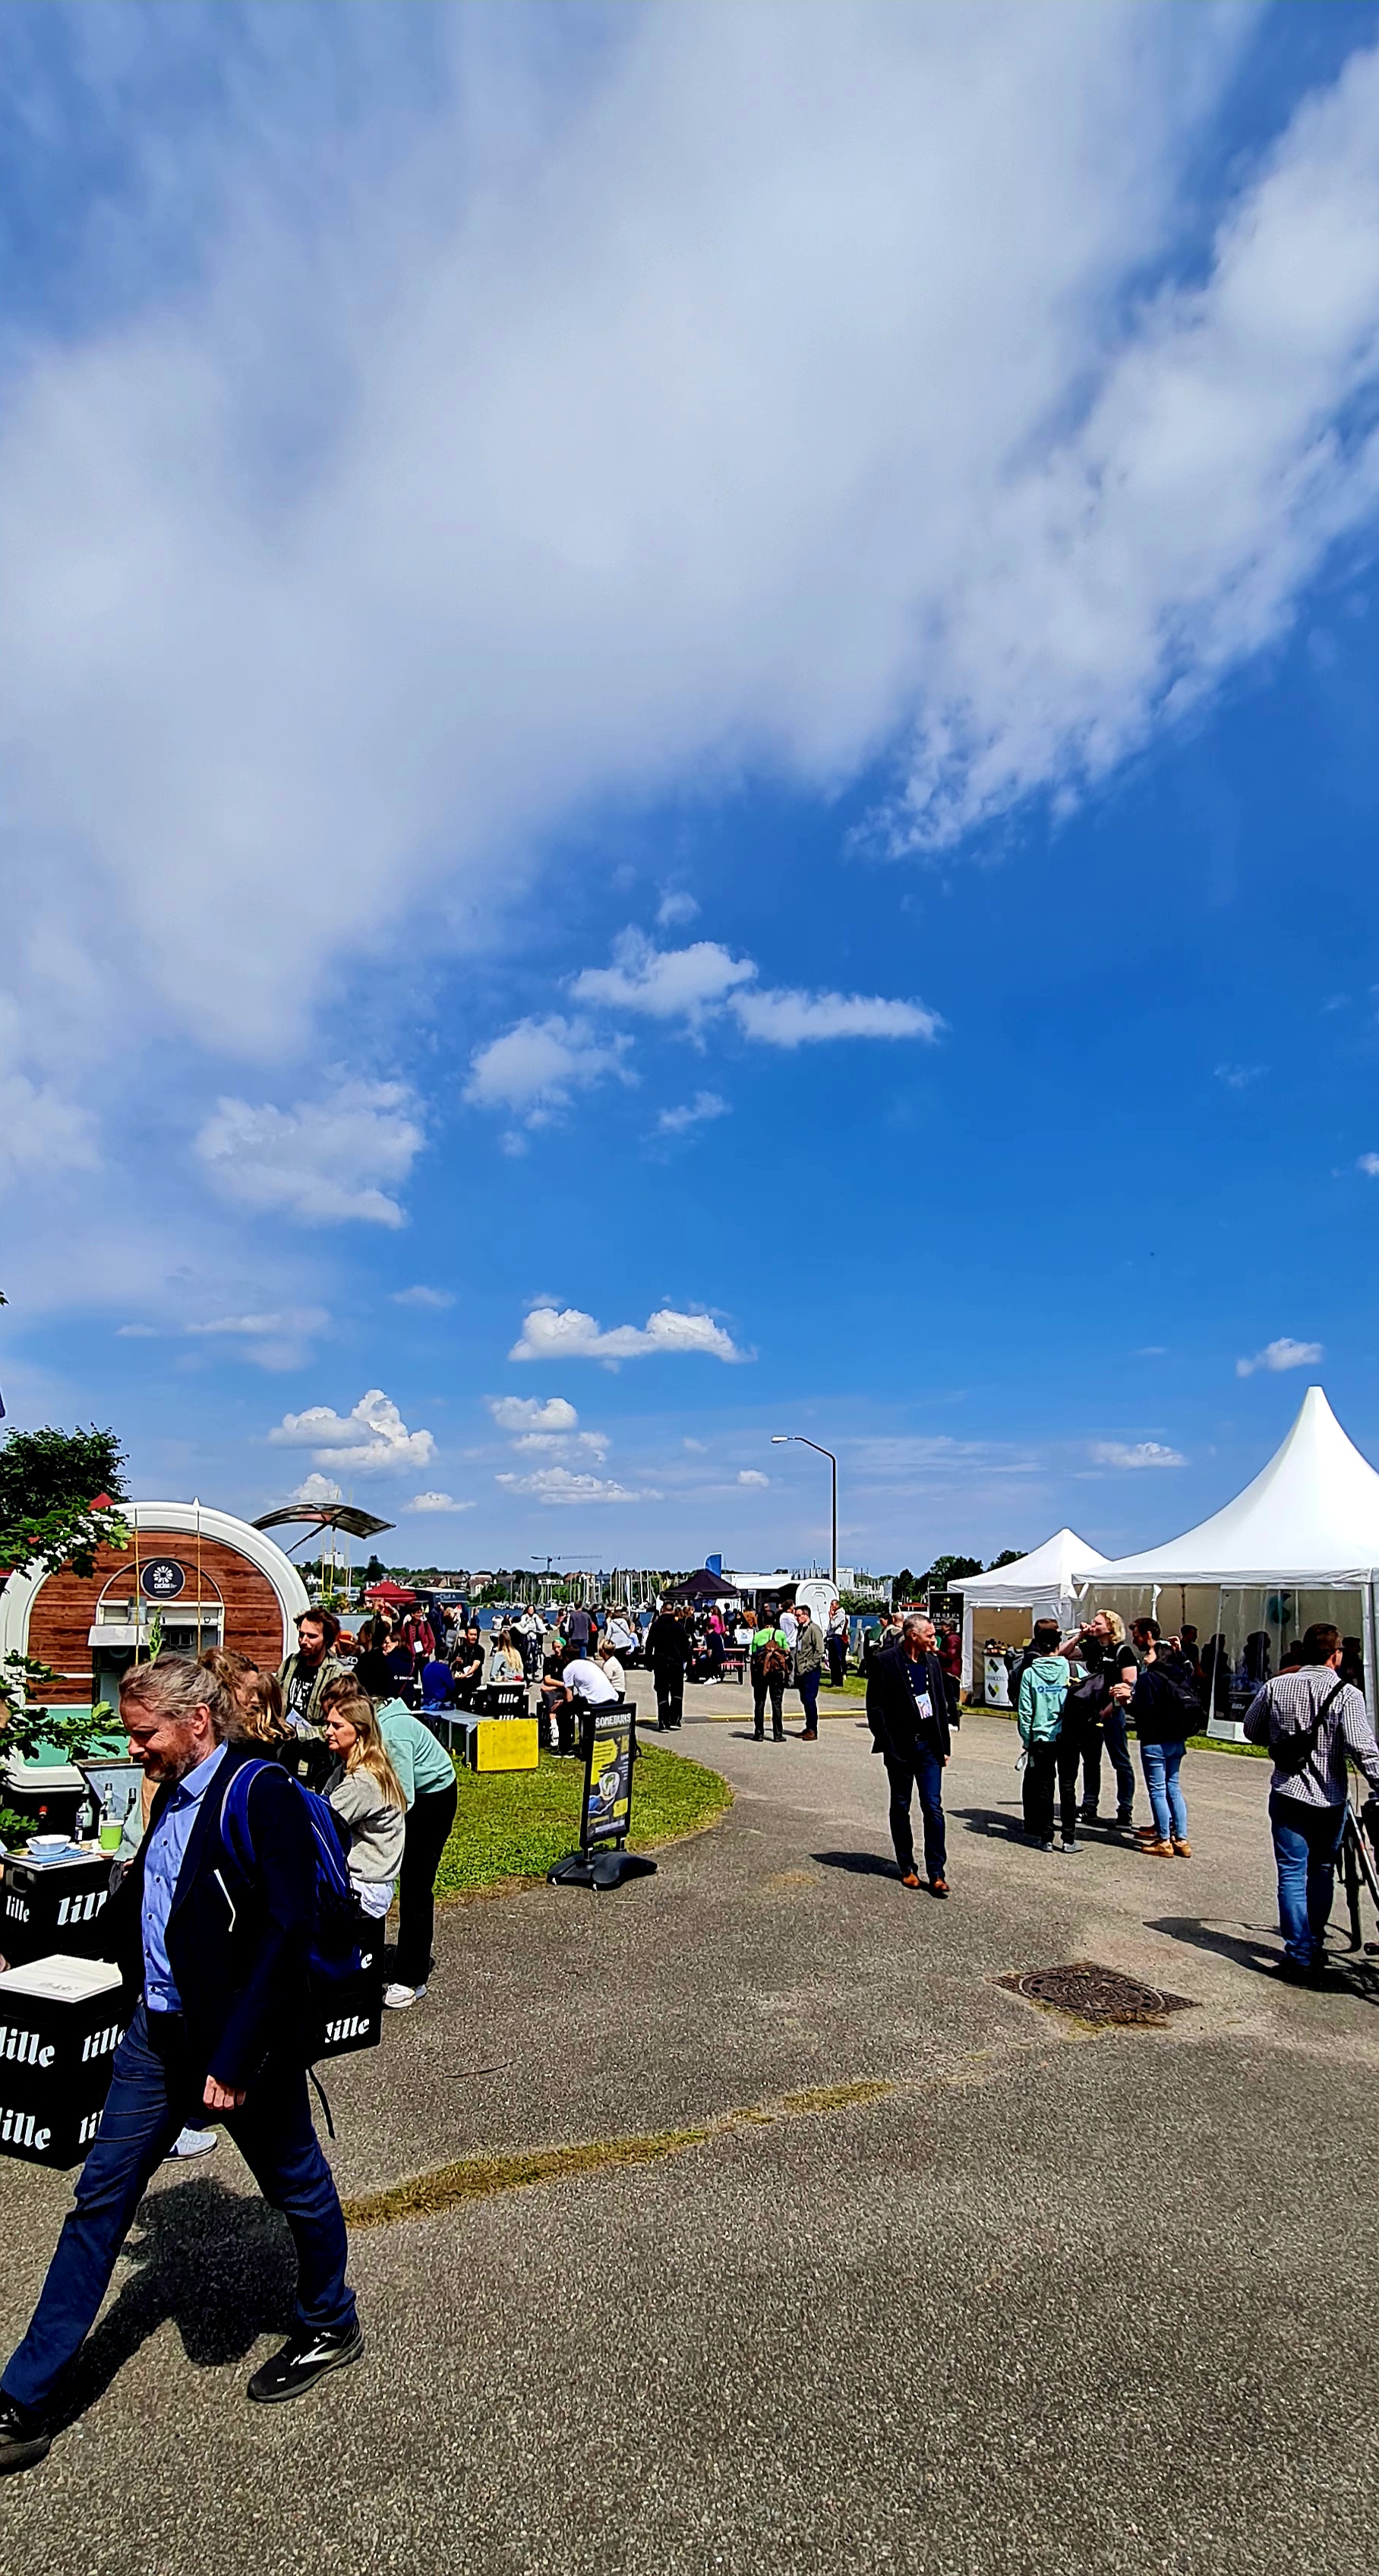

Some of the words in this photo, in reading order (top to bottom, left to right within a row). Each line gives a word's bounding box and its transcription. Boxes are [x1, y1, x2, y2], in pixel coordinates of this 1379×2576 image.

[498, 1694, 519, 1703] lille
[595, 1713, 631, 1728] SOMEBUNS
[6, 1896, 30, 1923] lille
[57, 1890, 108, 1925] lill
[324, 2016, 370, 2044] lille
[0, 2107, 51, 2150] ille
